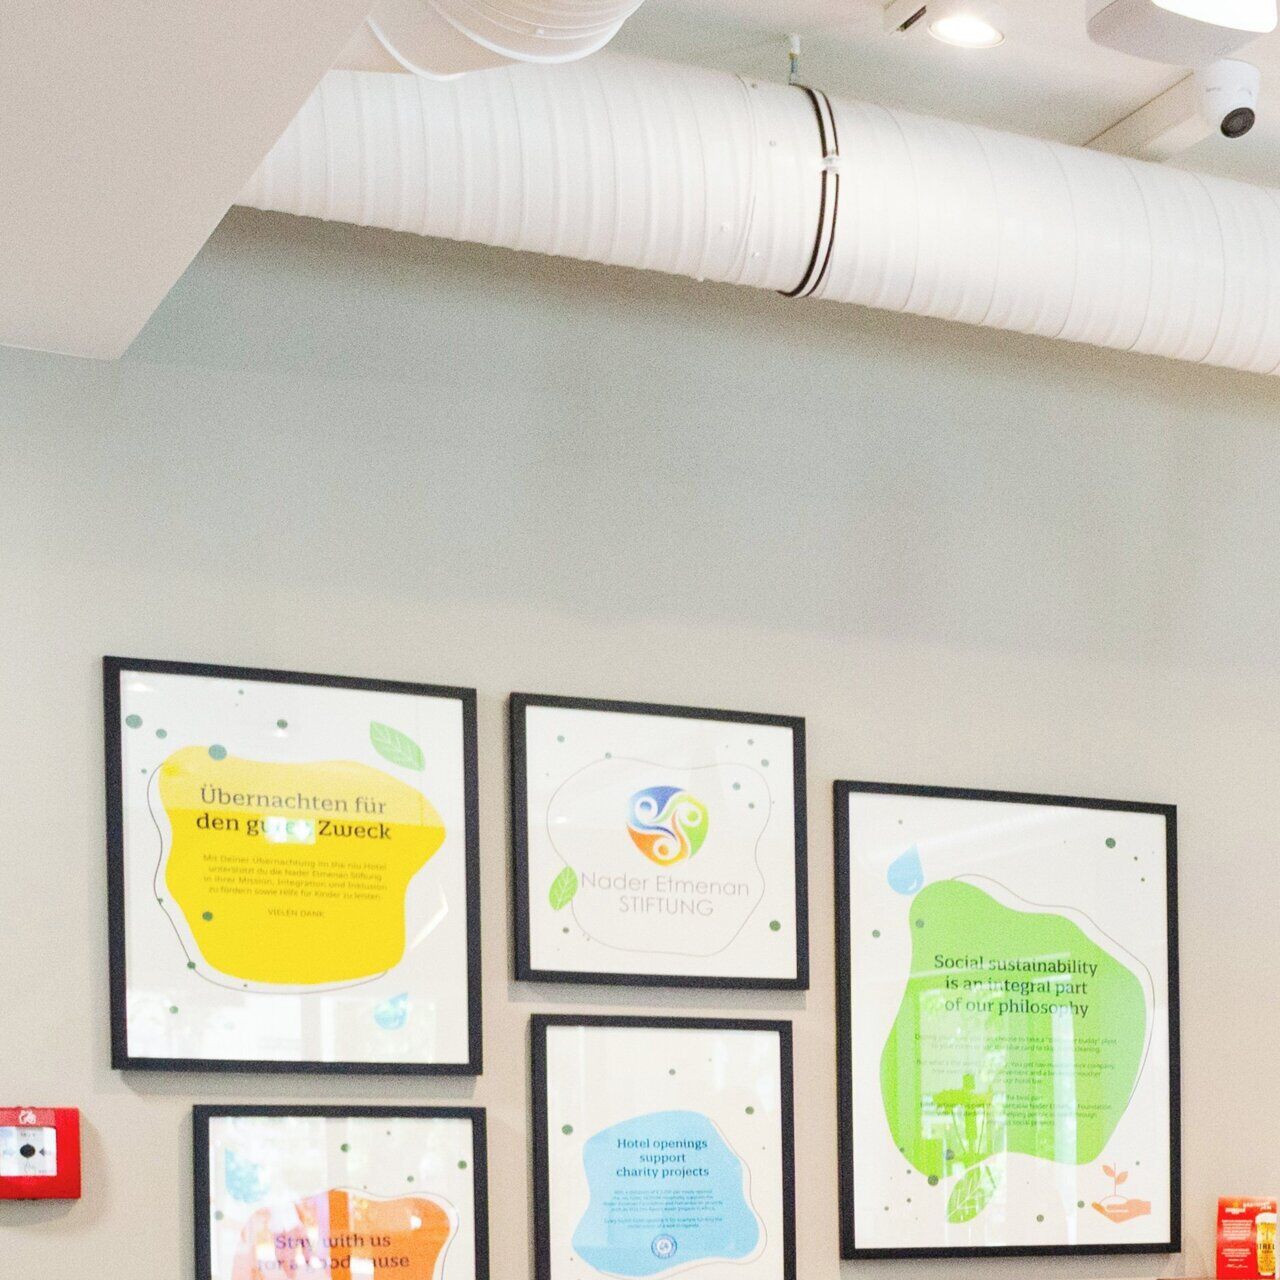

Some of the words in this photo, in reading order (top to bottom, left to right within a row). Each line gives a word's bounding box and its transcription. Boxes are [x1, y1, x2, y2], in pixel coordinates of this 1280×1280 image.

[200, 783, 348, 812] Übernachten
[355, 796, 386, 814] für
[196, 812, 240, 831] den
[318, 820, 392, 840] Zweck
[581, 872, 647, 893] Nader
[656, 874, 749, 897] Etmenan
[619, 893, 714, 917] STIFTUNG
[934, 954, 984, 971] Social
[988, 957, 1098, 978] sustainability
[945, 975, 959, 989] is
[963, 979, 983, 991] an
[1055, 980, 1087, 997] part
[944, 998, 962, 1011] of
[966, 1000, 994, 1012] our
[998, 999, 1089, 1018] philosophy
[617, 1138, 650, 1149] Hotel
[653, 1138, 708, 1150] openings
[639, 1153, 687, 1164] support
[616, 1167, 659, 1178] charity
[661, 1167, 710, 1179] projects
[322, 1233, 364, 1248] with
[370, 1236, 391, 1248] us
